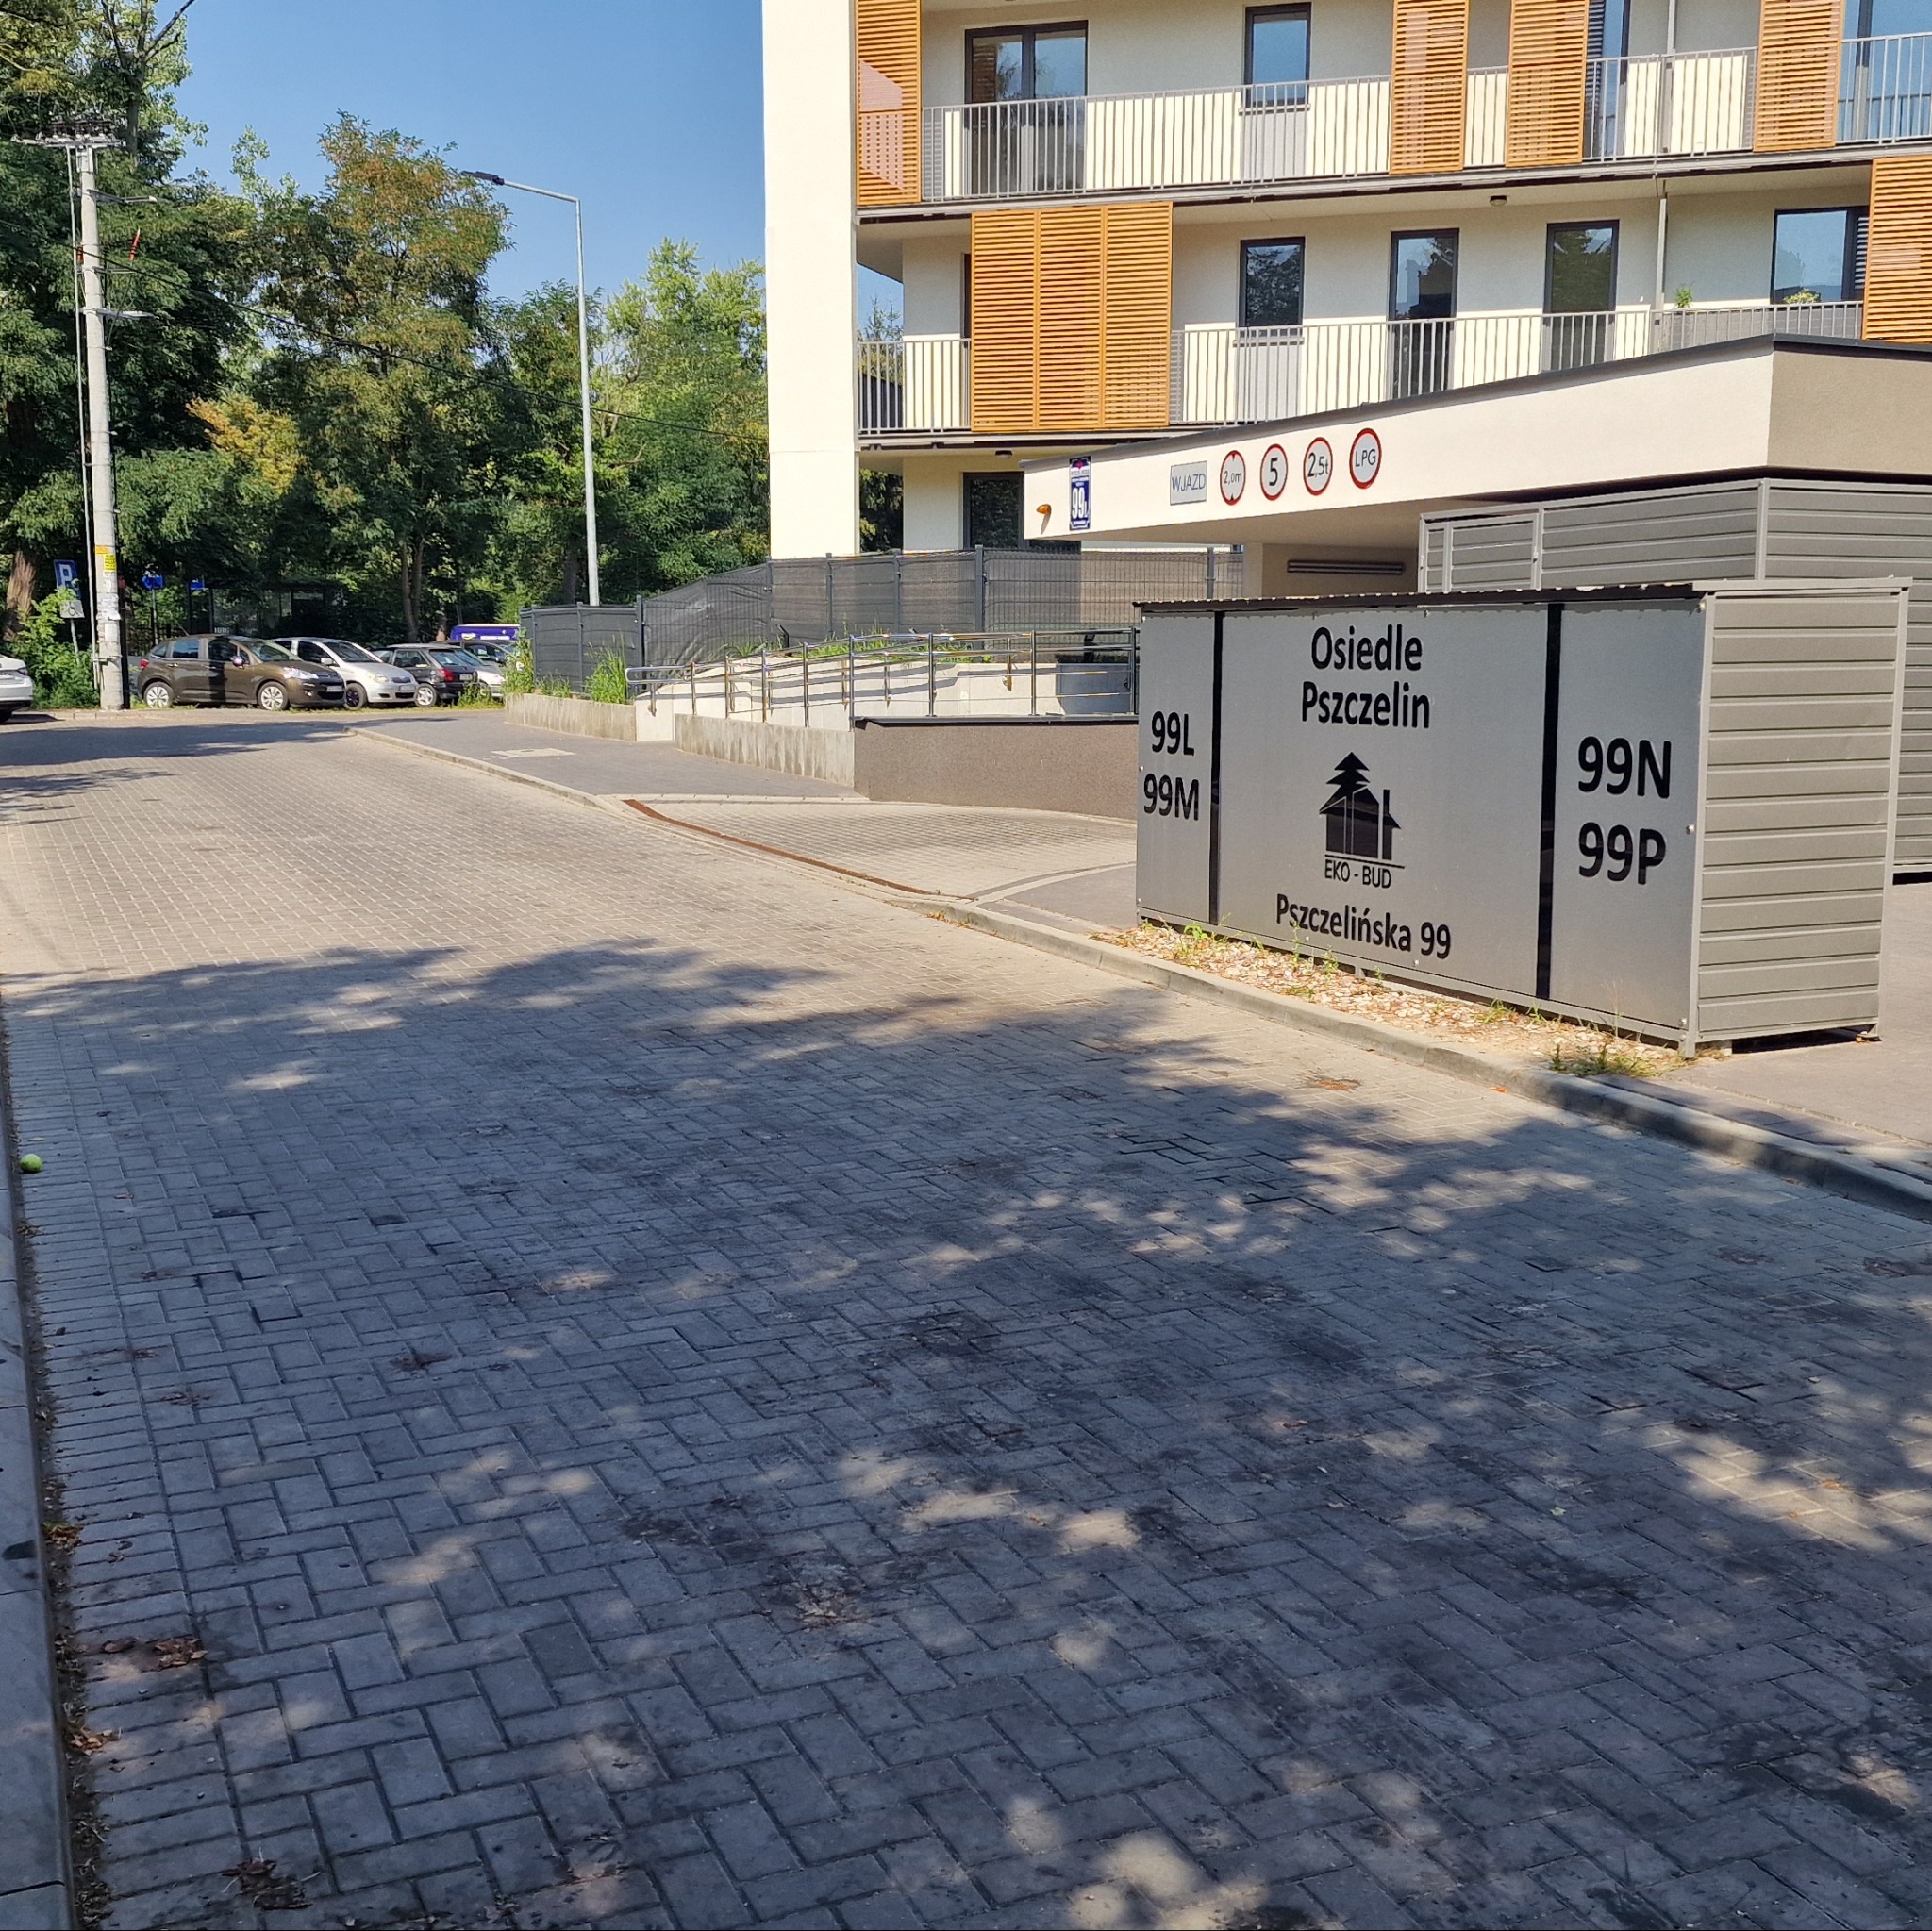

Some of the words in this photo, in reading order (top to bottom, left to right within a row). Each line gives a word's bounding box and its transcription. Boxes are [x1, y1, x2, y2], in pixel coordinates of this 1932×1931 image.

[1268, 457, 1278, 486] 5
[1307, 452, 1329, 478] 2,5t
[1355, 449, 1376, 467] LPG
[1171, 473, 1206, 492] WJAZD
[59, 564, 74, 591] P
[1311, 624, 1423, 671] Osiedle
[1302, 681, 1430, 728] Pszczelin
[1151, 710, 1195, 757] 99L
[1578, 736, 1672, 799] 99N
[1143, 773, 1199, 821] 99M
[1324, 859, 1351, 882] EKO
[1362, 865, 1391, 889] BUD
[1578, 822, 1666, 885] 99P
[1276, 893, 1412, 952] Pszczelińska
[1420, 922, 1451, 959] 99
